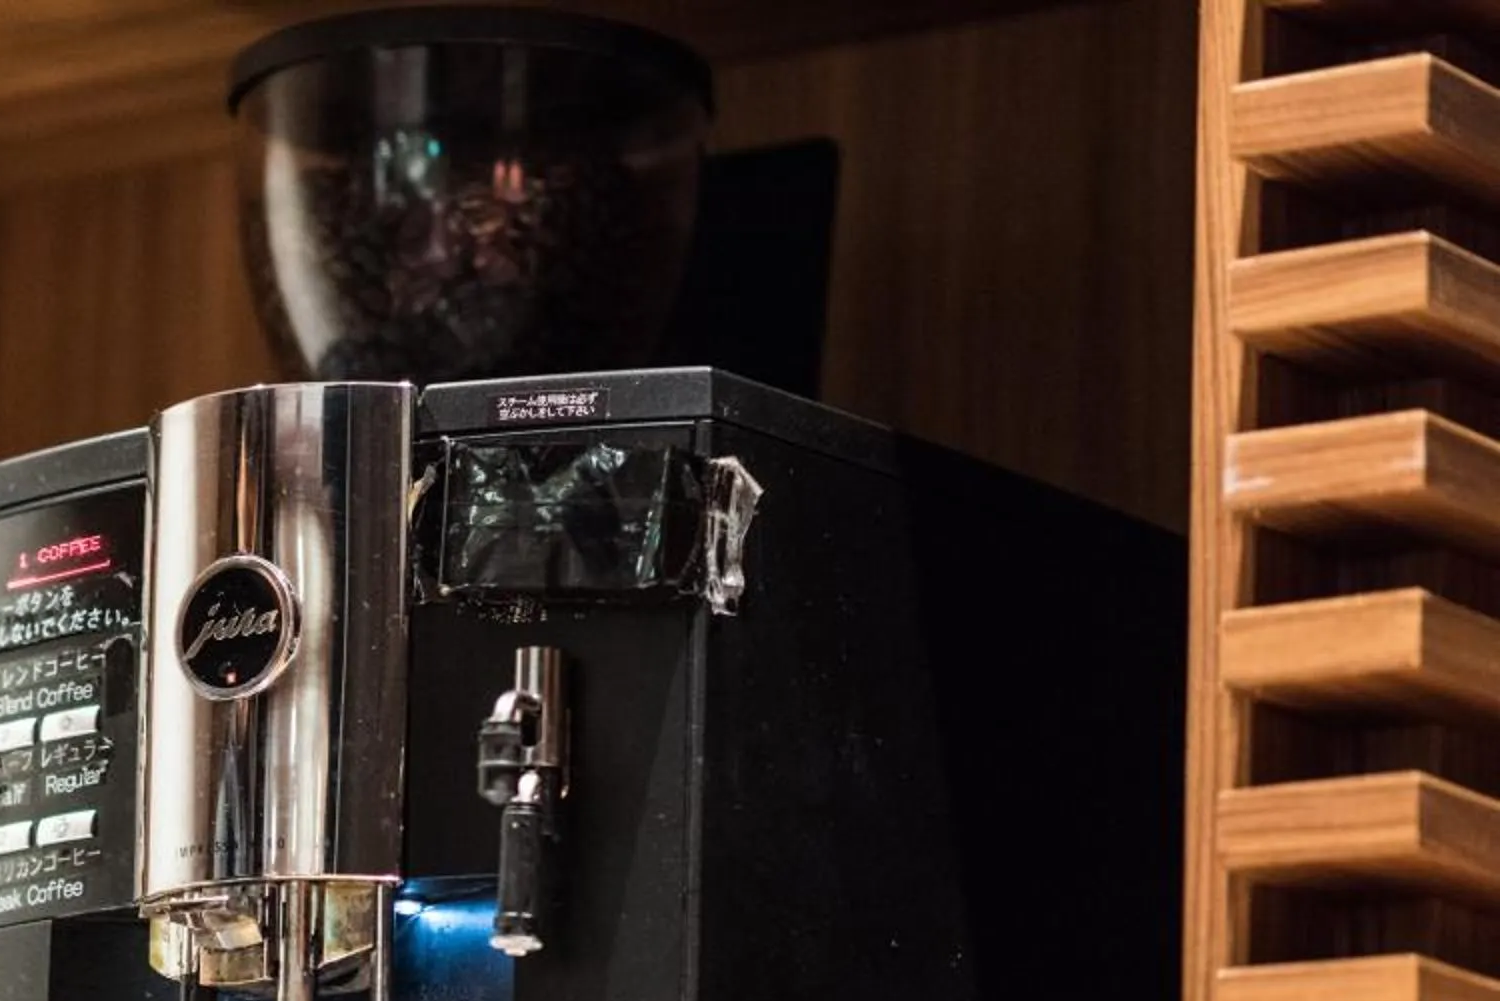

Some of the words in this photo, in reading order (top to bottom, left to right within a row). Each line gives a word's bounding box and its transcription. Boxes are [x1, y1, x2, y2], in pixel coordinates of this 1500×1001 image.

[36, 535, 102, 563] COFFEE
[181, 602, 279, 662] jura
[37, 680, 94, 709] Coffee
[26, 877, 84, 907] Coffee
